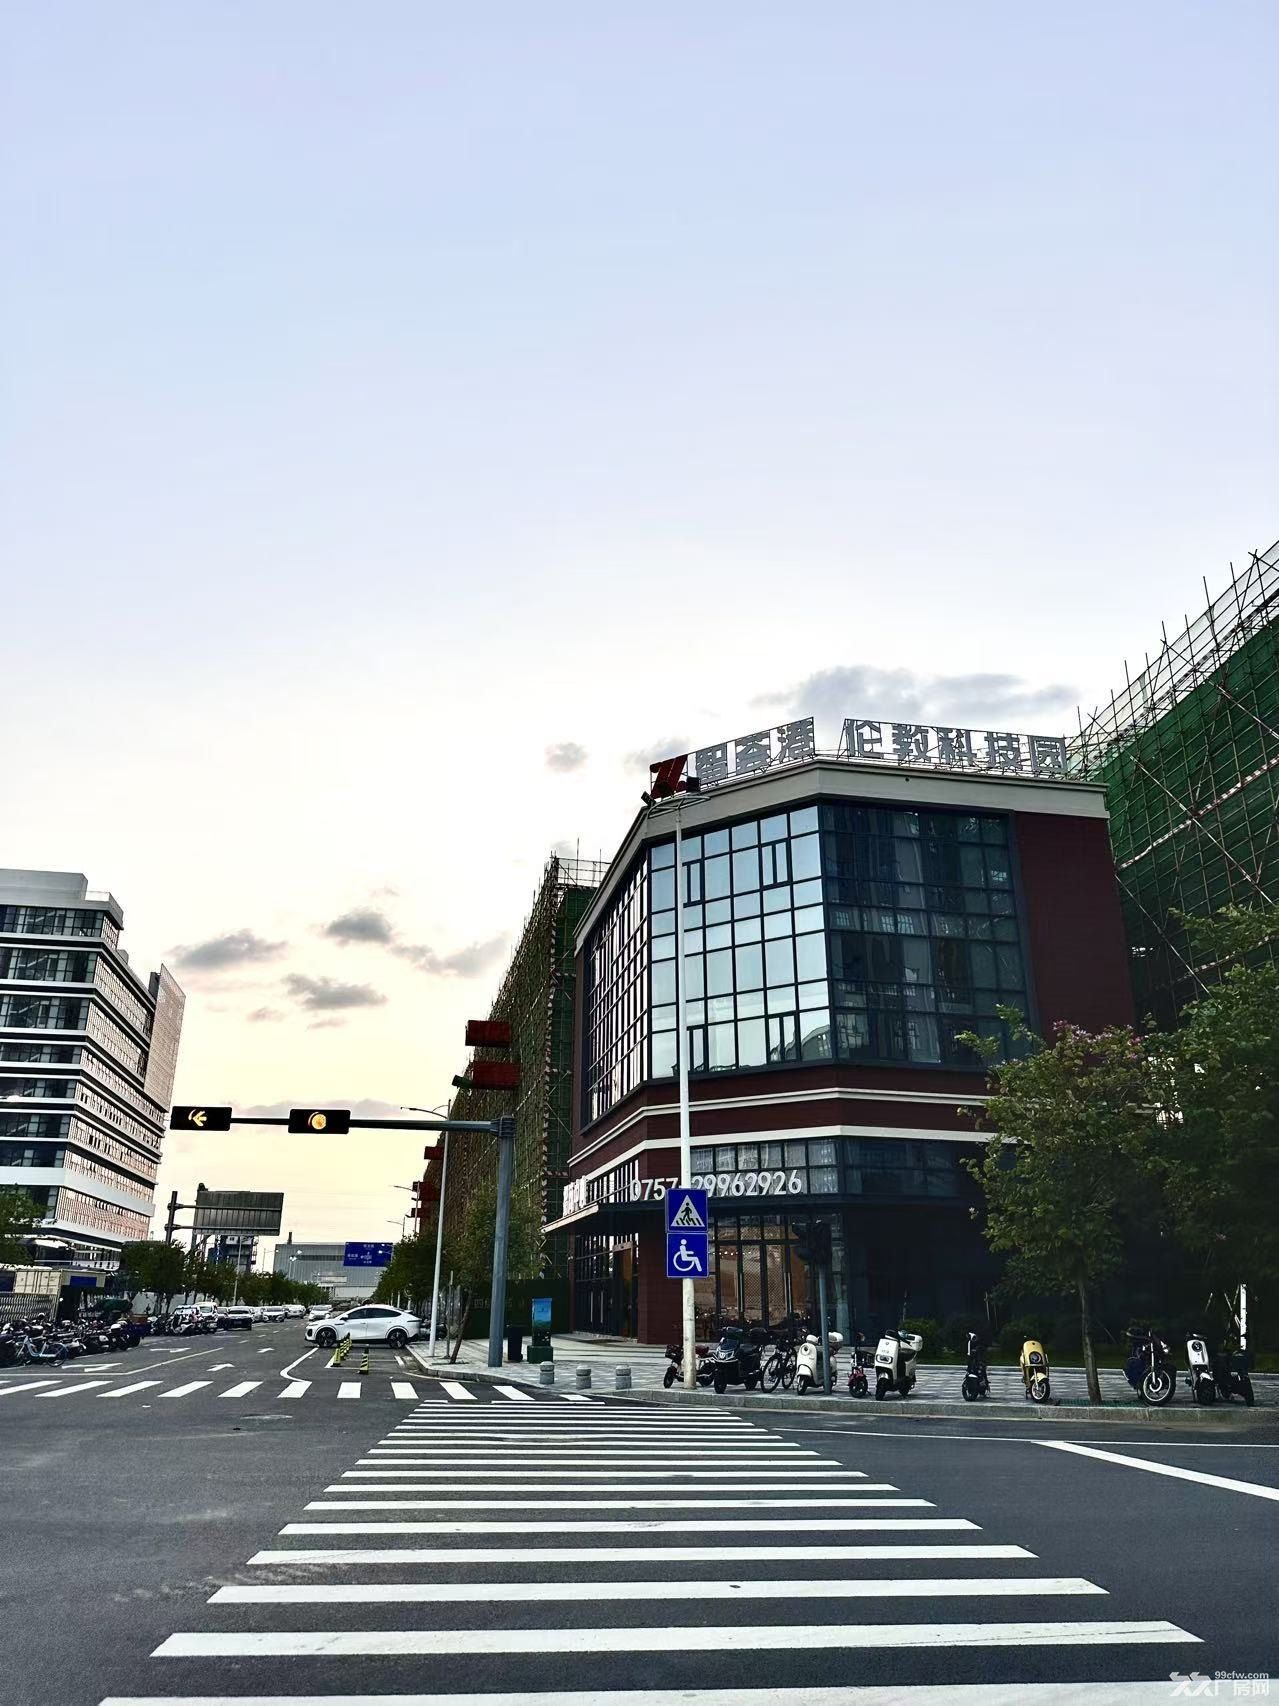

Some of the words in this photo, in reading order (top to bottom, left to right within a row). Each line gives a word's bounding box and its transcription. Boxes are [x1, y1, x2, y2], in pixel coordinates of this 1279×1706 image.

[845, 720, 1068, 775] 伦教科技园
